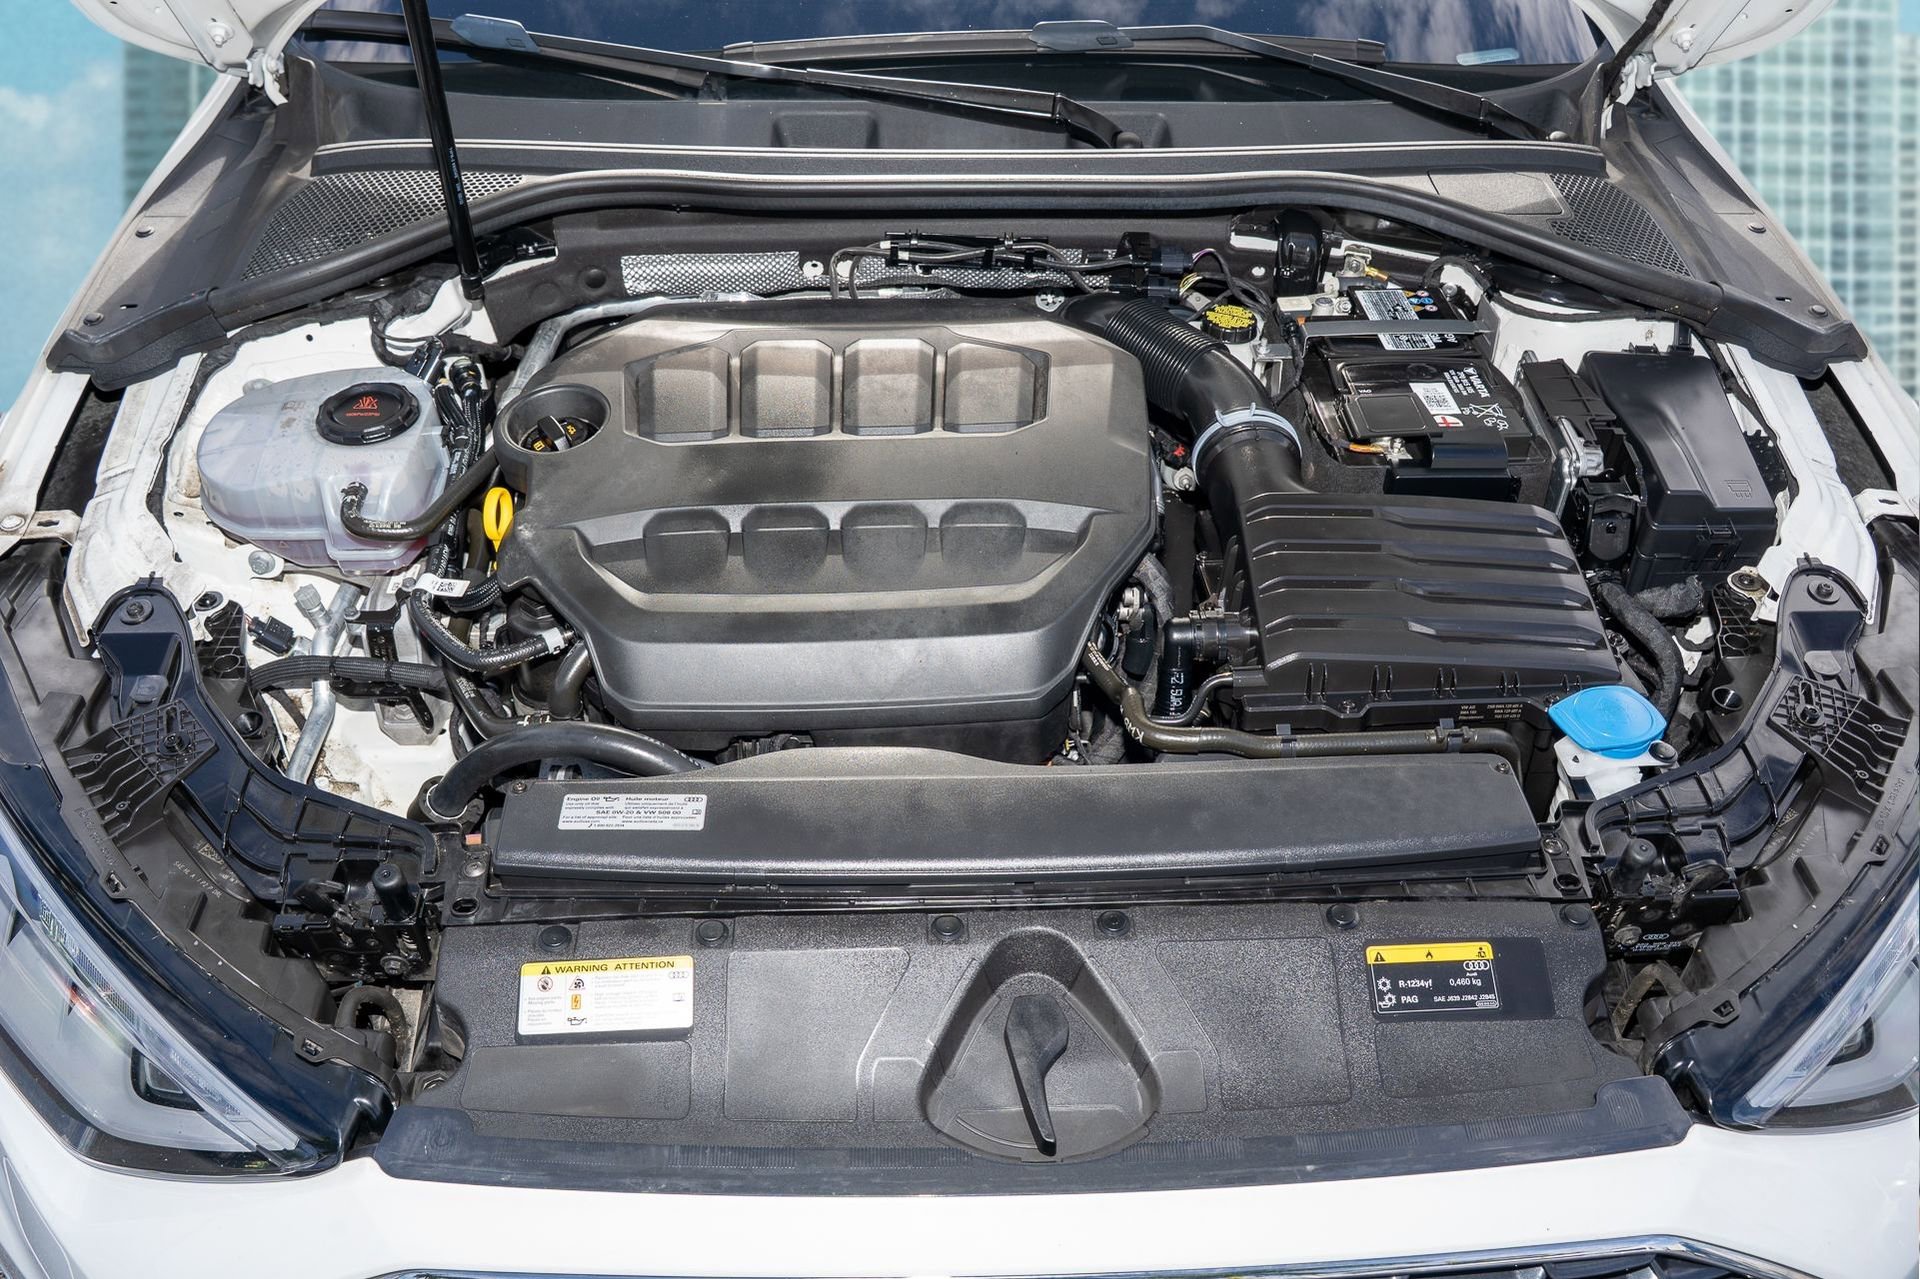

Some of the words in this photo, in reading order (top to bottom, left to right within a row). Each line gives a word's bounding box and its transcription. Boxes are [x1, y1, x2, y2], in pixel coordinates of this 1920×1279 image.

[1470, 376, 1491, 398] VARTA
[555, 963, 608, 974] WARNING
[614, 960, 675, 971] ATTENTION
[1399, 978, 1433, 989] R-1234yf
[1449, 978, 1470, 986] 0,460
[1472, 977, 1482, 986] kg
[1401, 995, 1419, 1003] PAG
